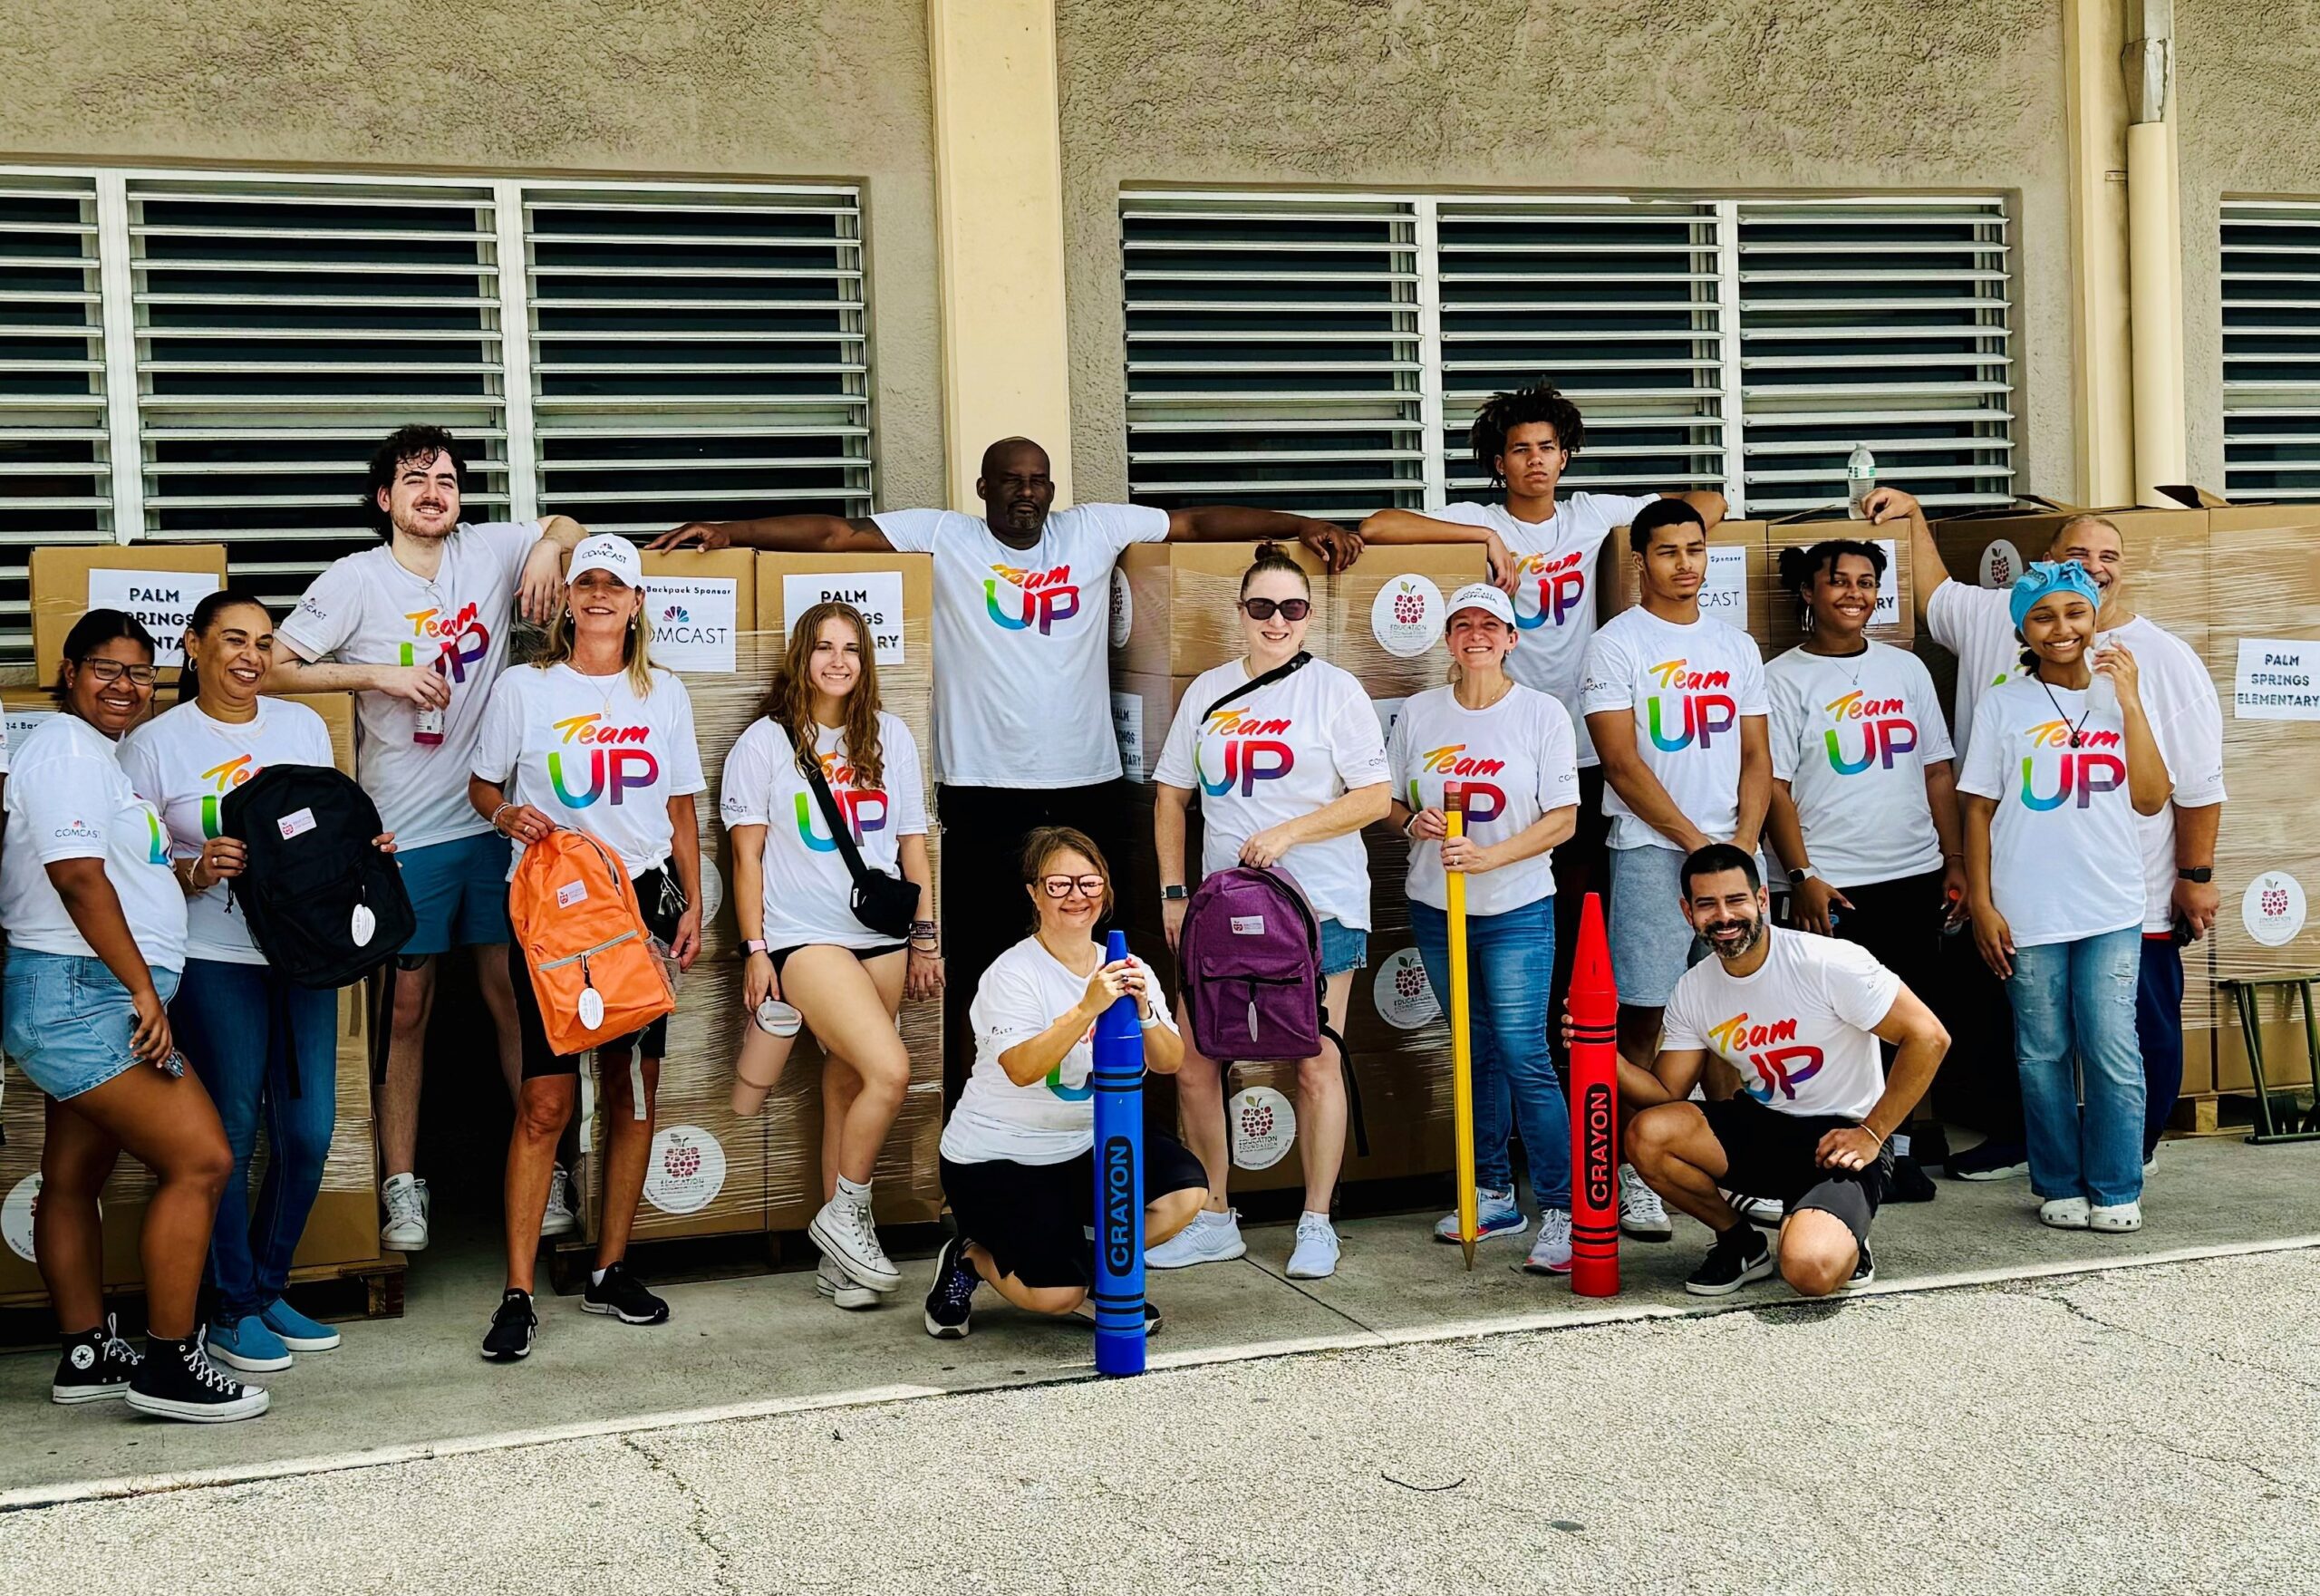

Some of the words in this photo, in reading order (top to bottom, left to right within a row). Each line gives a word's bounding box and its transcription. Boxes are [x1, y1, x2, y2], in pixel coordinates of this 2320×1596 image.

[581, 549, 627, 564] COMCAST
[646, 585, 691, 595] Backpack
[694, 586, 731, 595] Sponsor
[990, 564, 1070, 590] Team
[130, 587, 179, 604] PALM
[819, 590, 867, 604] PALM
[982, 579, 1080, 636] UP
[1697, 592, 1740, 608] CAST
[126, 611, 193, 626] PRINGS
[403, 602, 478, 637] Team
[649, 627, 728, 644] MCAST
[1648, 659, 1730, 691] Team
[2265, 653, 2300, 667] PALM
[2251, 673, 2310, 687] SPRINGS
[1825, 691, 1906, 722] Team
[2238, 692, 2320, 707] ELEMENTARY
[553, 713, 650, 746] Team
[1207, 706, 1292, 736] Team
[1647, 694, 1737, 753] UP
[2024, 719, 2121, 750] Team
[1422, 744, 1505, 777] Team
[1824, 718, 1918, 777] UP
[201, 753, 262, 793] Te
[547, 749, 660, 809] UP
[1194, 740, 1295, 798] UP
[2021, 753, 2126, 812] UP
[794, 788, 888, 852] UP
[1394, 995, 1431, 1007] EDUCAT
[1707, 1011, 1796, 1054] Team
[1740, 1046, 1823, 1106] UP
[1592, 1090, 1610, 1204] CRAYON
[1110, 1145, 1128, 1267] CRAYON
